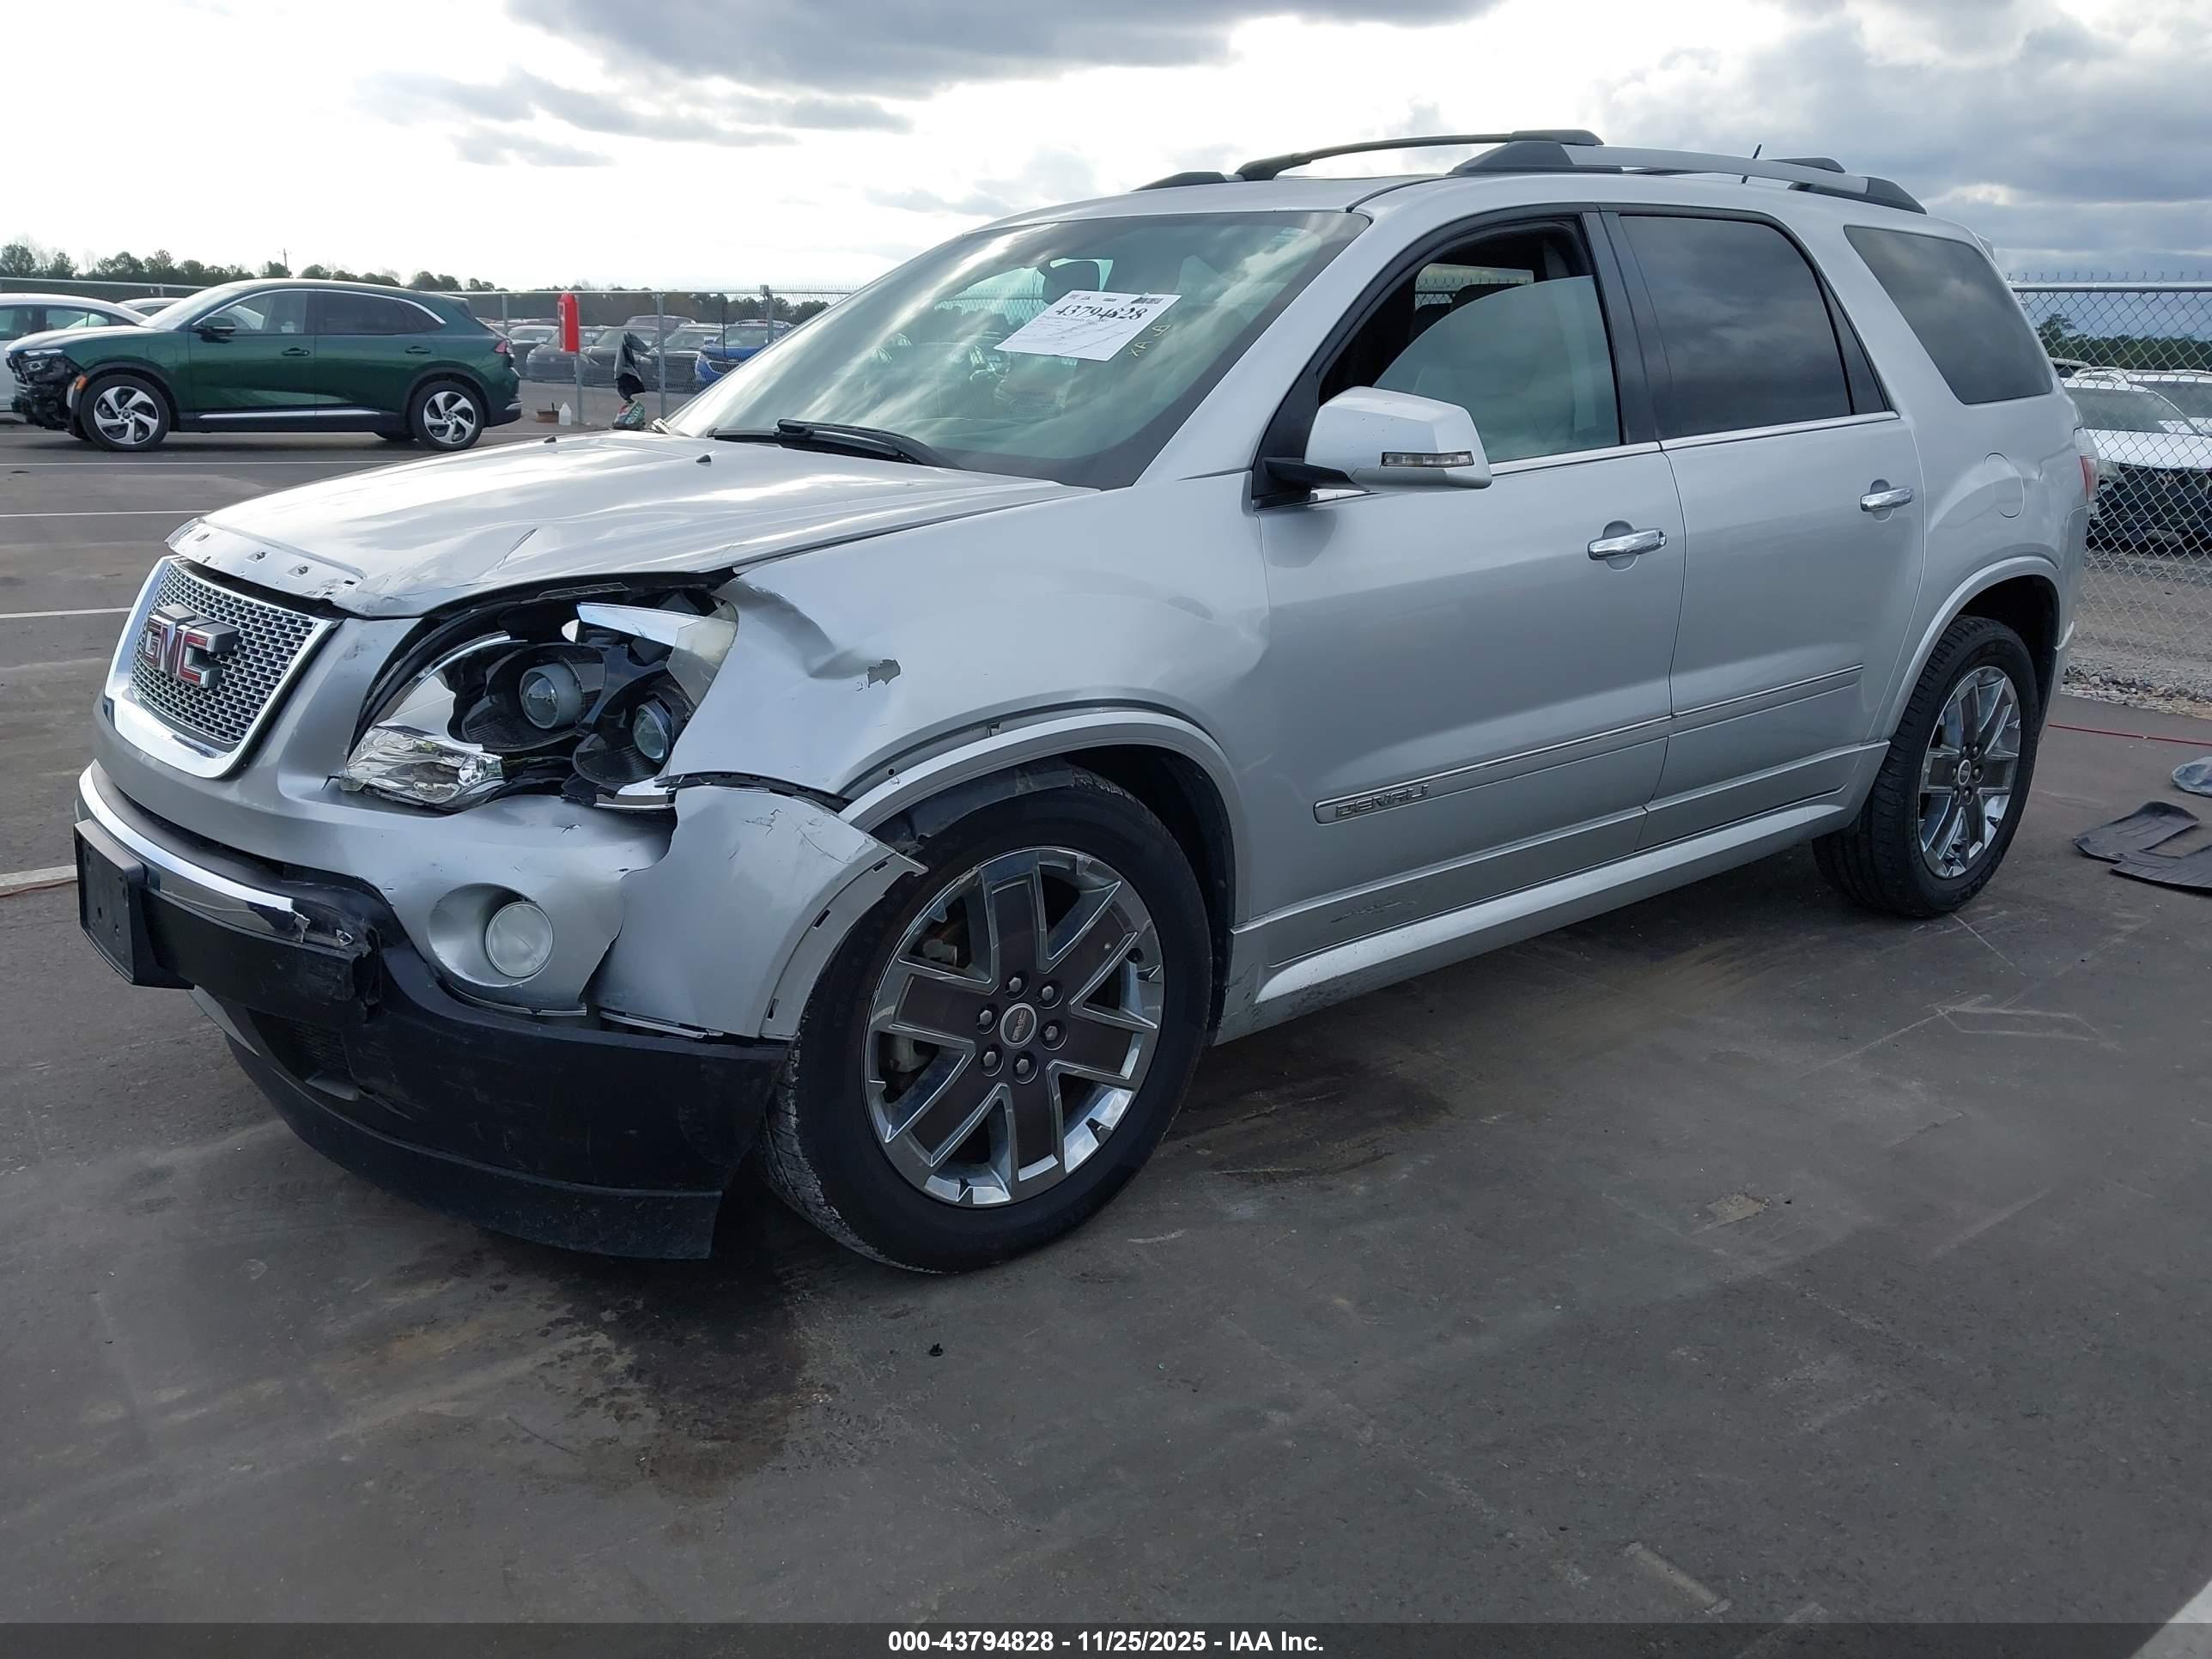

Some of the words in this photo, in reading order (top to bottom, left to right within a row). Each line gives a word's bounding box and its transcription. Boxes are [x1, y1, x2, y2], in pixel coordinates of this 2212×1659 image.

[1056, 305, 1148, 320] 43794828
[143, 608, 225, 689] GMC
[1335, 784, 1430, 817] DENALI
